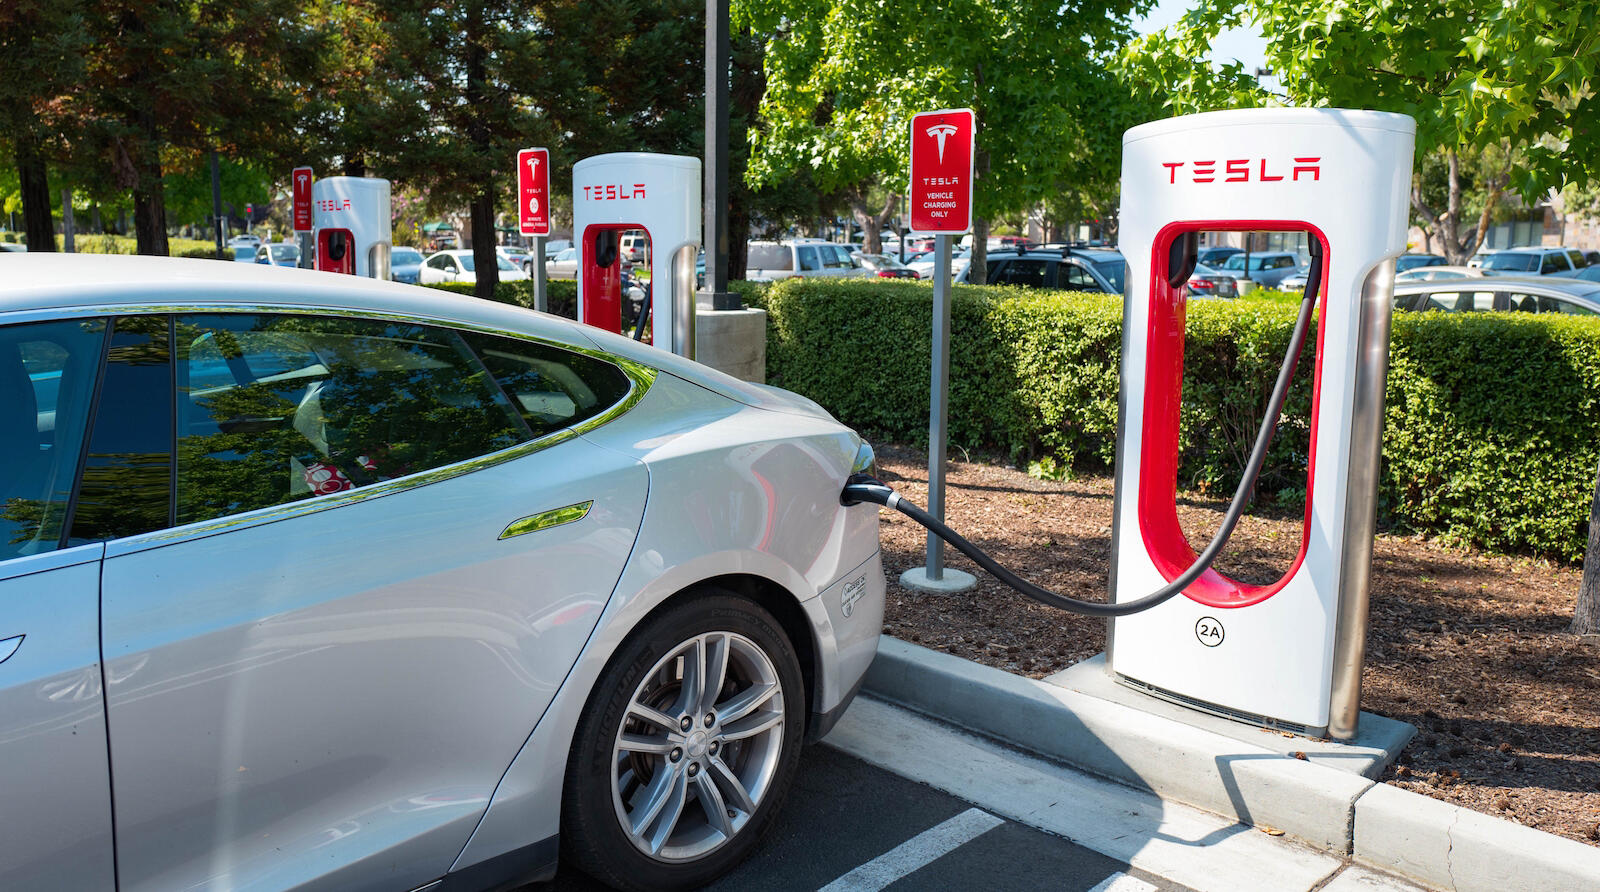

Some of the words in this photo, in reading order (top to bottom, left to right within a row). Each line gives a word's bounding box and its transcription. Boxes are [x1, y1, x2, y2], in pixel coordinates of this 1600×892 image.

[1162, 157, 1321, 184] TESLA
[923, 176, 958, 185] TESLA
[583, 183, 646, 200] TESLA
[316, 199, 351, 212] TESLA
[1200, 624, 1220, 638] 2A
